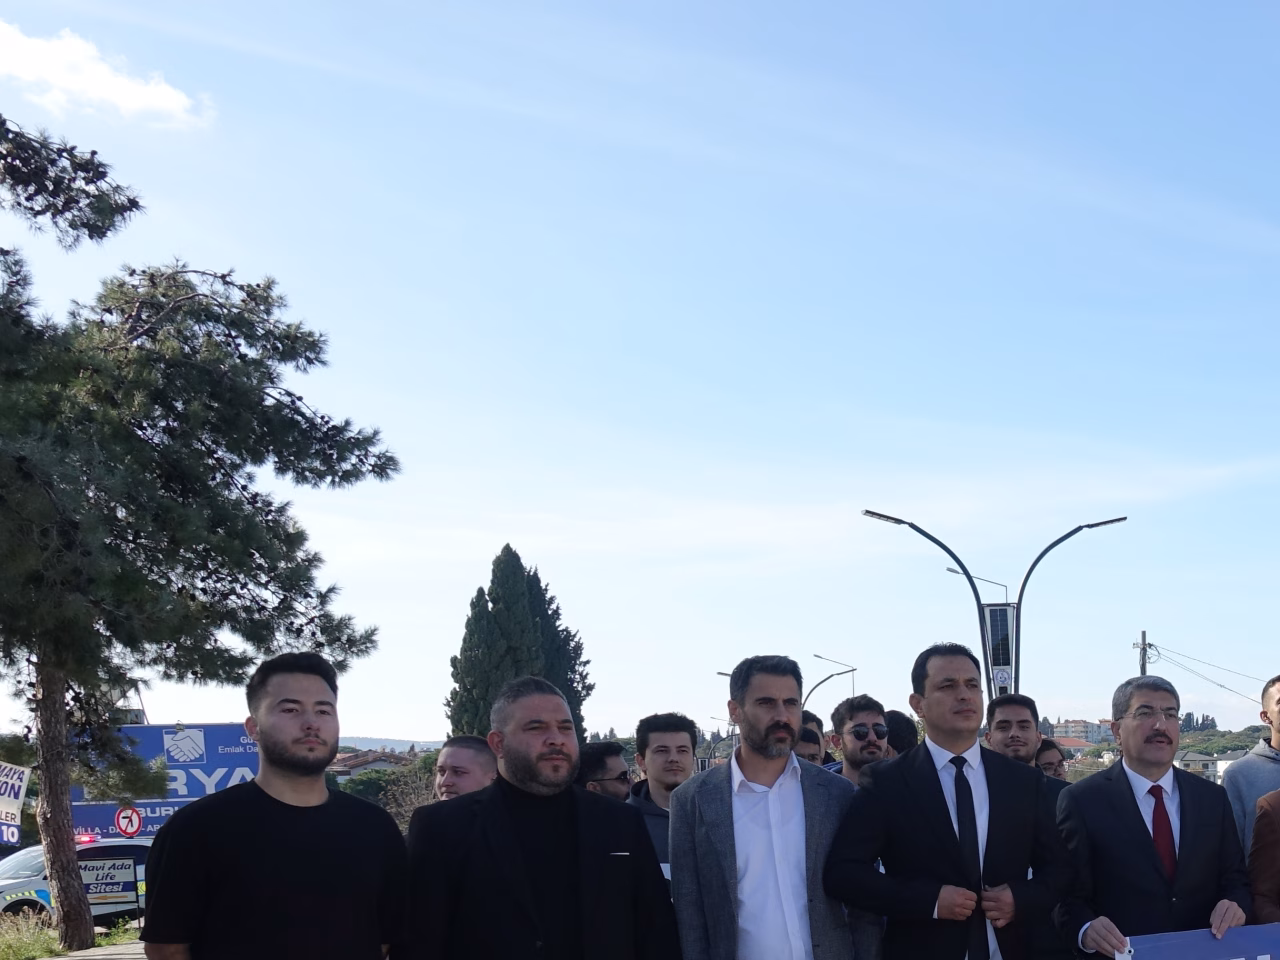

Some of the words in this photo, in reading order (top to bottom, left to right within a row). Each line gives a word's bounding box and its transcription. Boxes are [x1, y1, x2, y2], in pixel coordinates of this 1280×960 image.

[246, 745, 259, 753] Da
[0, 765, 25, 783] MAYA
[164, 767, 255, 797] RYA
[0, 781, 22, 800] ON
[0, 810, 17, 823] LER
[136, 806, 179, 818] BUR
[79, 862, 107, 872] Mavi
[108, 862, 132, 871] Ada
[95, 872, 116, 881] Life
[88, 882, 124, 893] Sitesi
